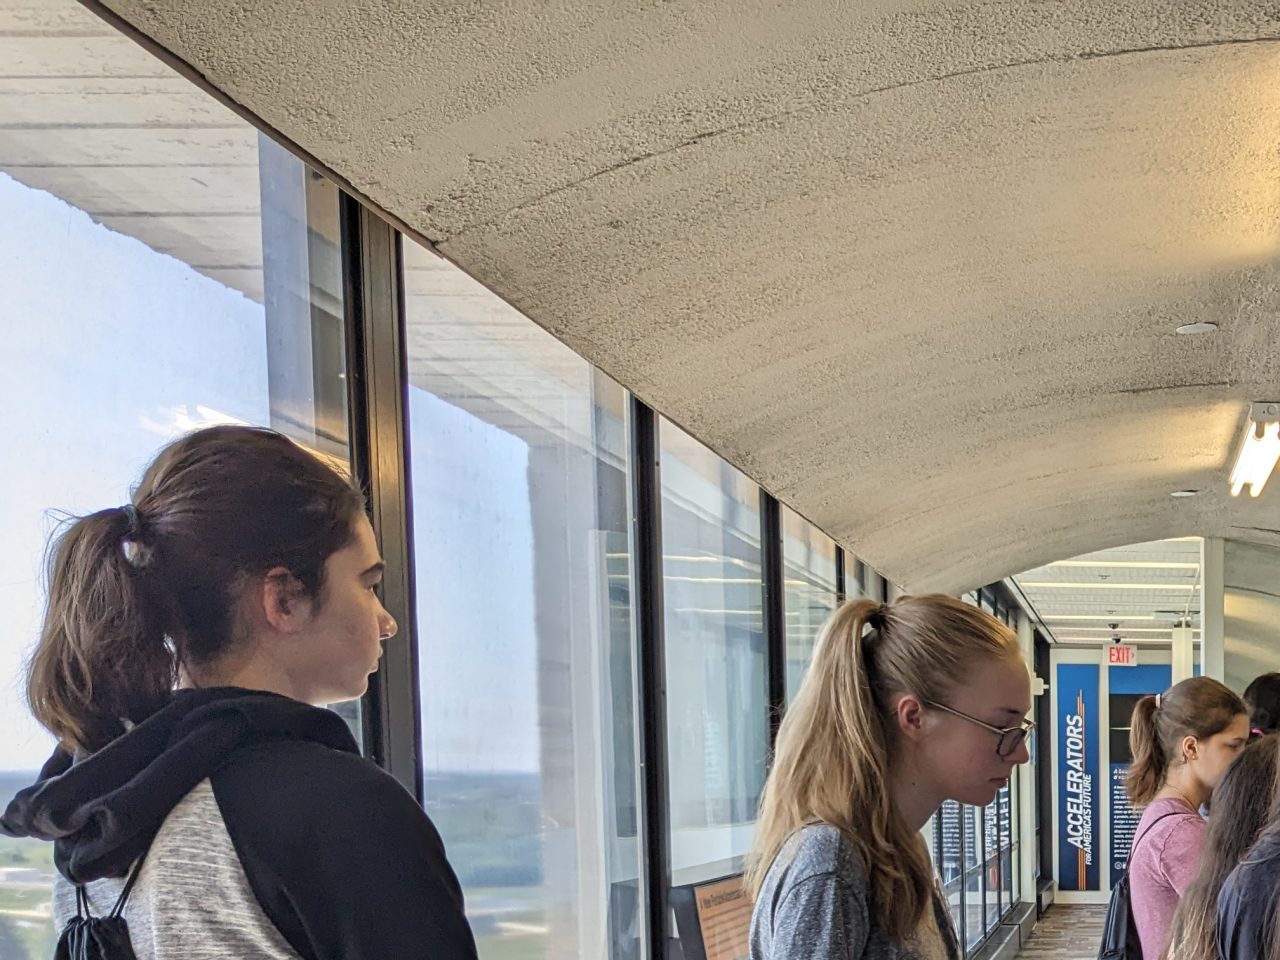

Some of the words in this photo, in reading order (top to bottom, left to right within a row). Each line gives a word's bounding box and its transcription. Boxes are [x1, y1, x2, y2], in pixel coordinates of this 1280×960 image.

[1109, 647, 1130, 663] EXIT
[1066, 714, 1083, 849] ACCELERATORS
[1083, 773, 1092, 808] FUTURE
